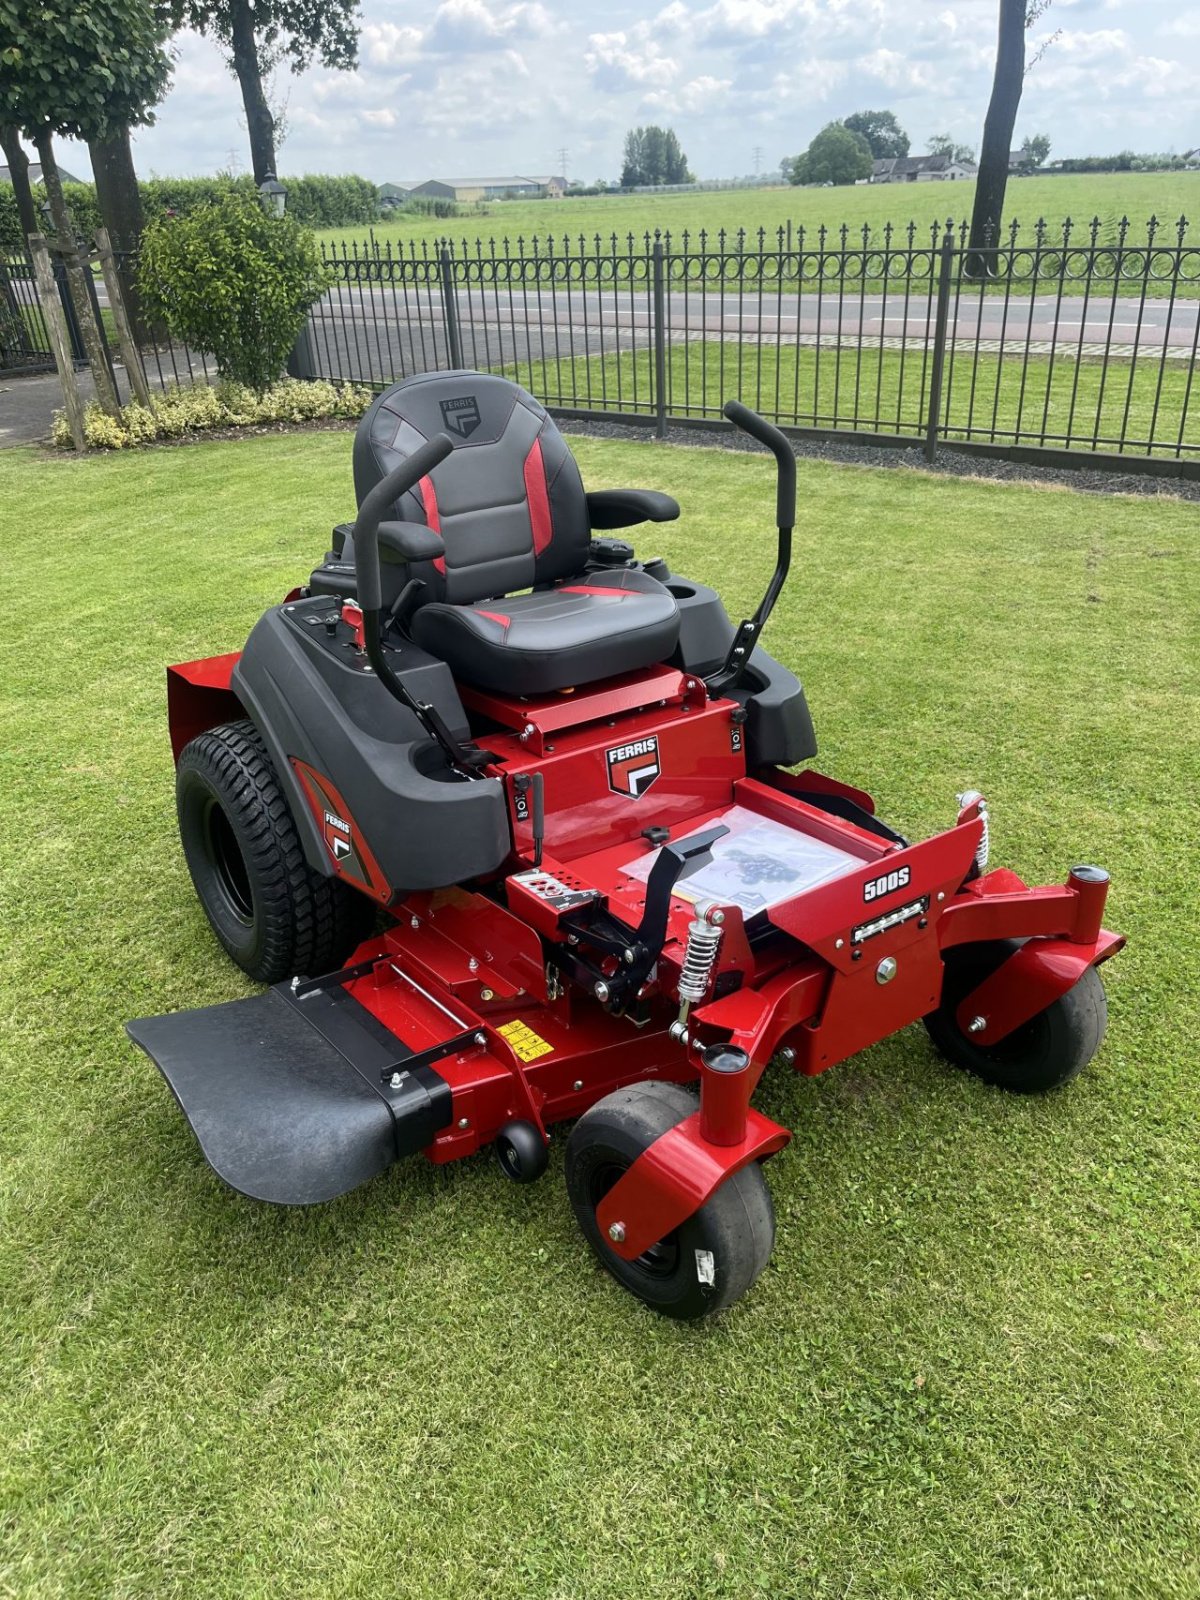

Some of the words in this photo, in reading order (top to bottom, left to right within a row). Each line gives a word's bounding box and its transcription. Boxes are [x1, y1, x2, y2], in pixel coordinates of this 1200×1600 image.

[442, 399, 475, 410] FERRIS
[608, 738, 656, 763] FERRIS
[325, 813, 350, 834] FERRIS
[864, 867, 909, 901] 500S
